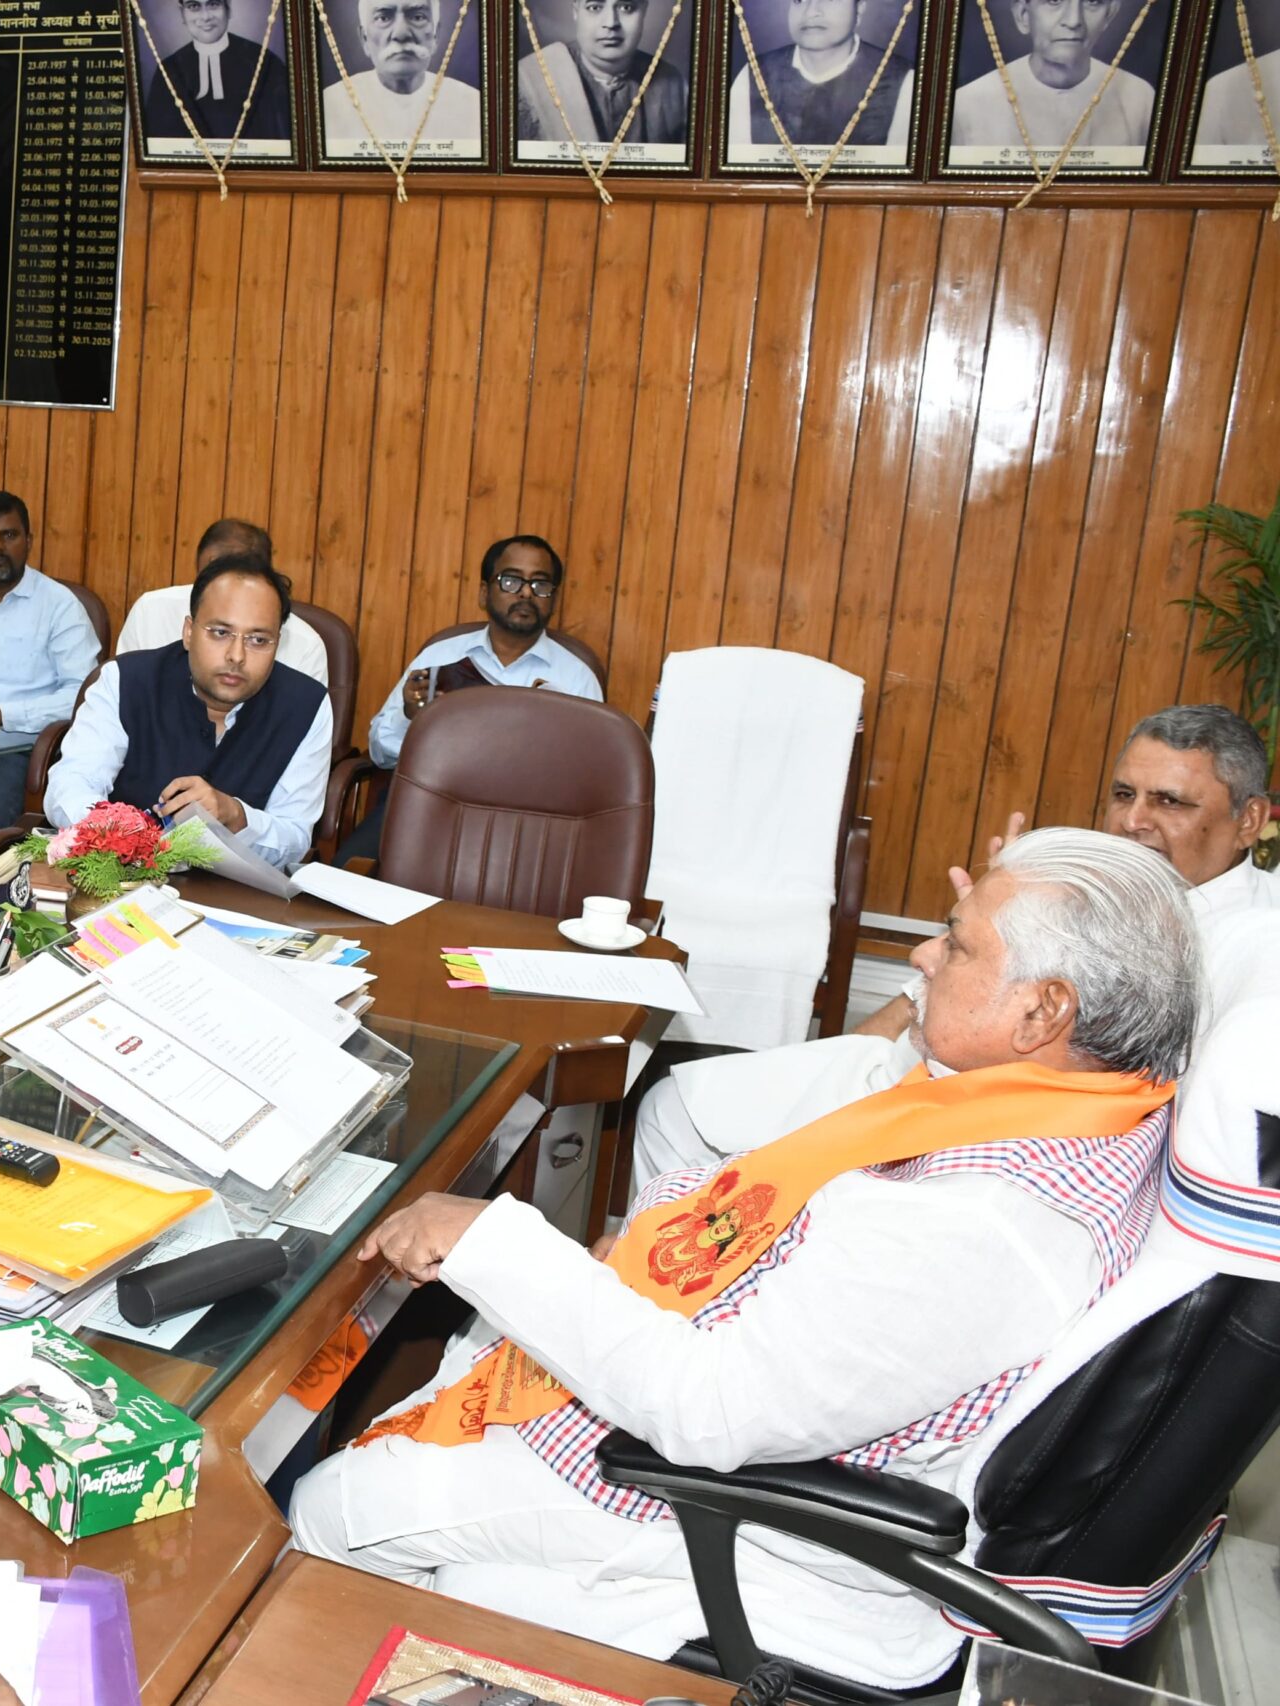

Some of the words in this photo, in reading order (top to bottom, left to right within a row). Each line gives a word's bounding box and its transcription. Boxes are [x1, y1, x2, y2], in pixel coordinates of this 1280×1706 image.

[23, 1, 40, 10] सभा
[0, 13, 38, 28] माननीय
[41, 15, 73, 27] अध्यक्ष
[76, 10, 93, 26] की
[96, 9, 120, 30] सूची
[80, 1461, 145, 1497] Daffodil
[109, 1487, 127, 1497] Extra
[127, 1481, 143, 1494] Soft
